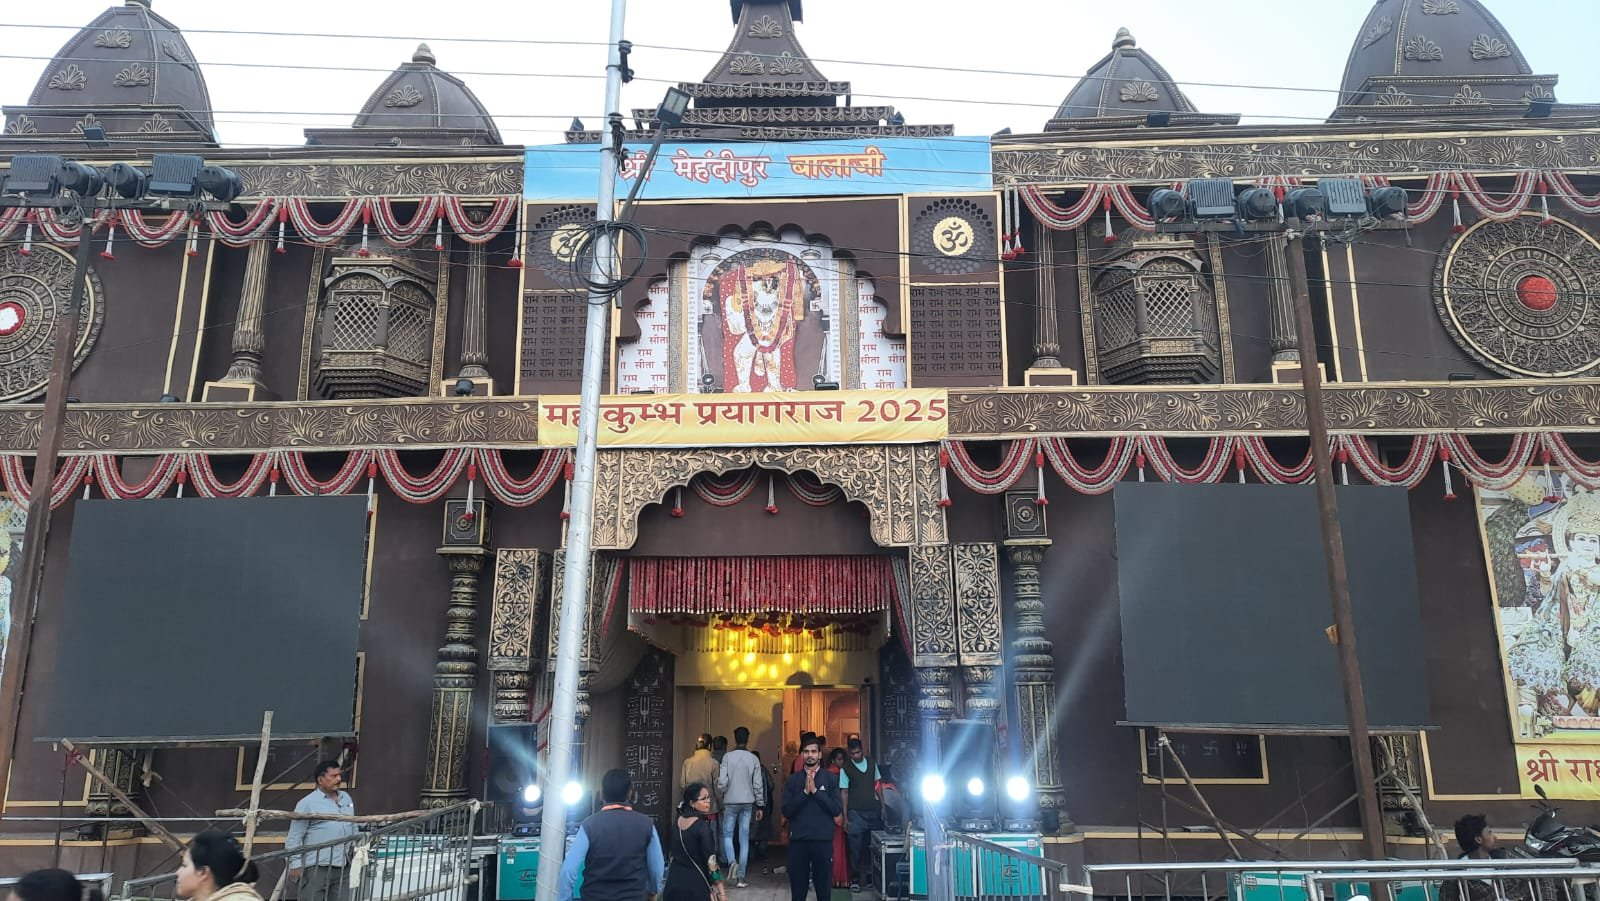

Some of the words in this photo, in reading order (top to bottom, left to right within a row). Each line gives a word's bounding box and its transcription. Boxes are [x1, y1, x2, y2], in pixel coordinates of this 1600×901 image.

[671, 148, 772, 187] मेहंदीपुर
[787, 145, 887, 180] बालाजी
[862, 344, 877, 352] राम
[634, 359, 655, 369] सीता
[876, 369, 892, 377] राम
[542, 401, 685, 433] महकुम्भ
[693, 400, 845, 425] प्रयागराज
[857, 399, 947, 423] 2025
[1526, 749, 1560, 782] श्री
